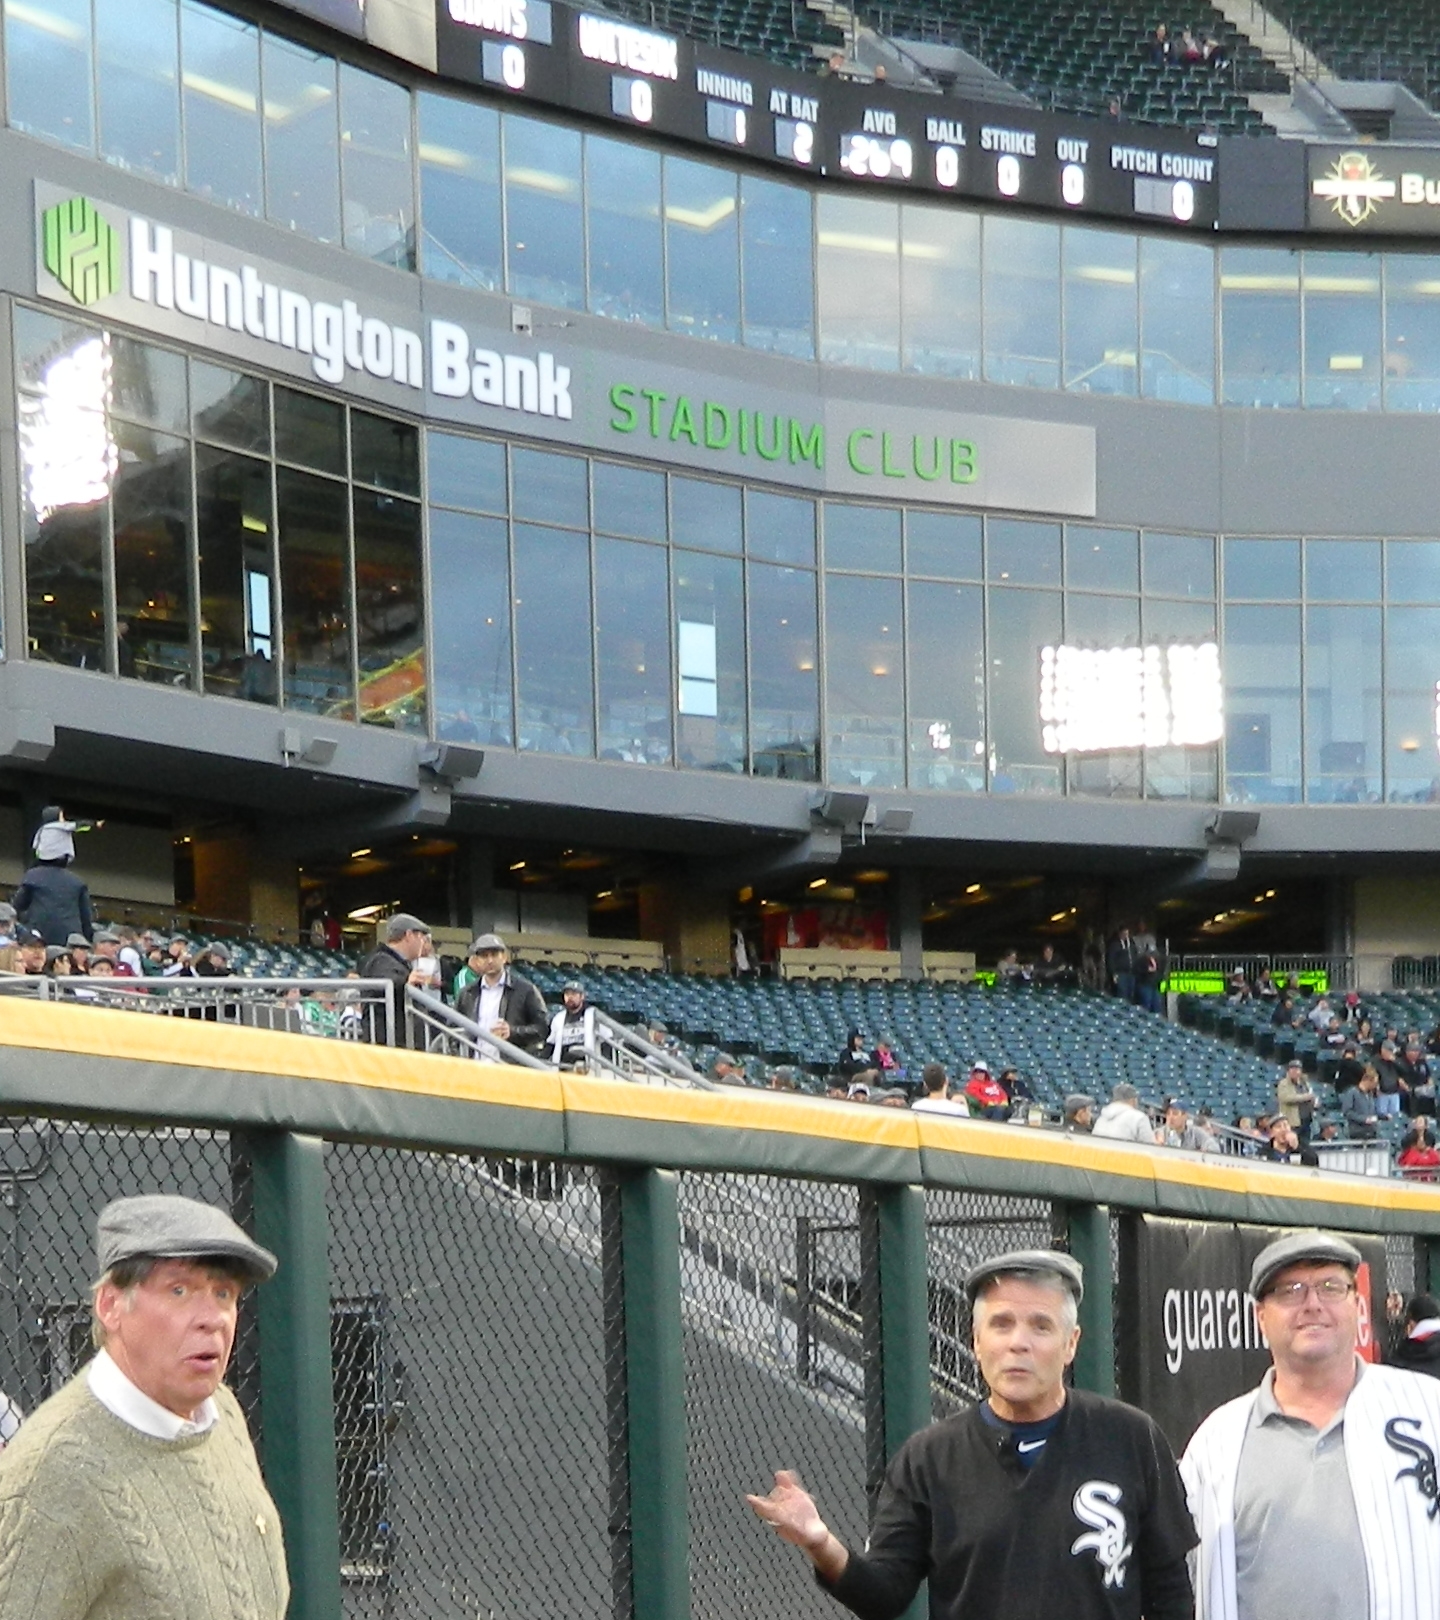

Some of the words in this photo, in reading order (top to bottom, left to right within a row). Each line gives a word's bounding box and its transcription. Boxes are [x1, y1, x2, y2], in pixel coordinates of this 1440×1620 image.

[502, 44, 525, 90] 0
[697, 69, 752, 106] INNING
[630, 79, 652, 122] 0
[770, 90, 787, 114] AT
[791, 95, 819, 123] BAT
[793, 122, 813, 164] 2
[863, 109, 896, 136] AVG
[927, 119, 966, 146] BALL
[981, 127, 1036, 157] STRIKE
[936, 146, 958, 187] 0
[1057, 140, 1089, 163] OUT
[1112, 146, 1157, 174] PITCH
[1161, 154, 1213, 182] COUNT
[1062, 164, 1084, 205] 0
[129, 215, 423, 389] Huntington
[430, 319, 573, 420] Bank
[610, 383, 825, 470] STADIUM
[848, 429, 978, 485] CLUB
[1164, 1288, 1267, 1374] guaran
